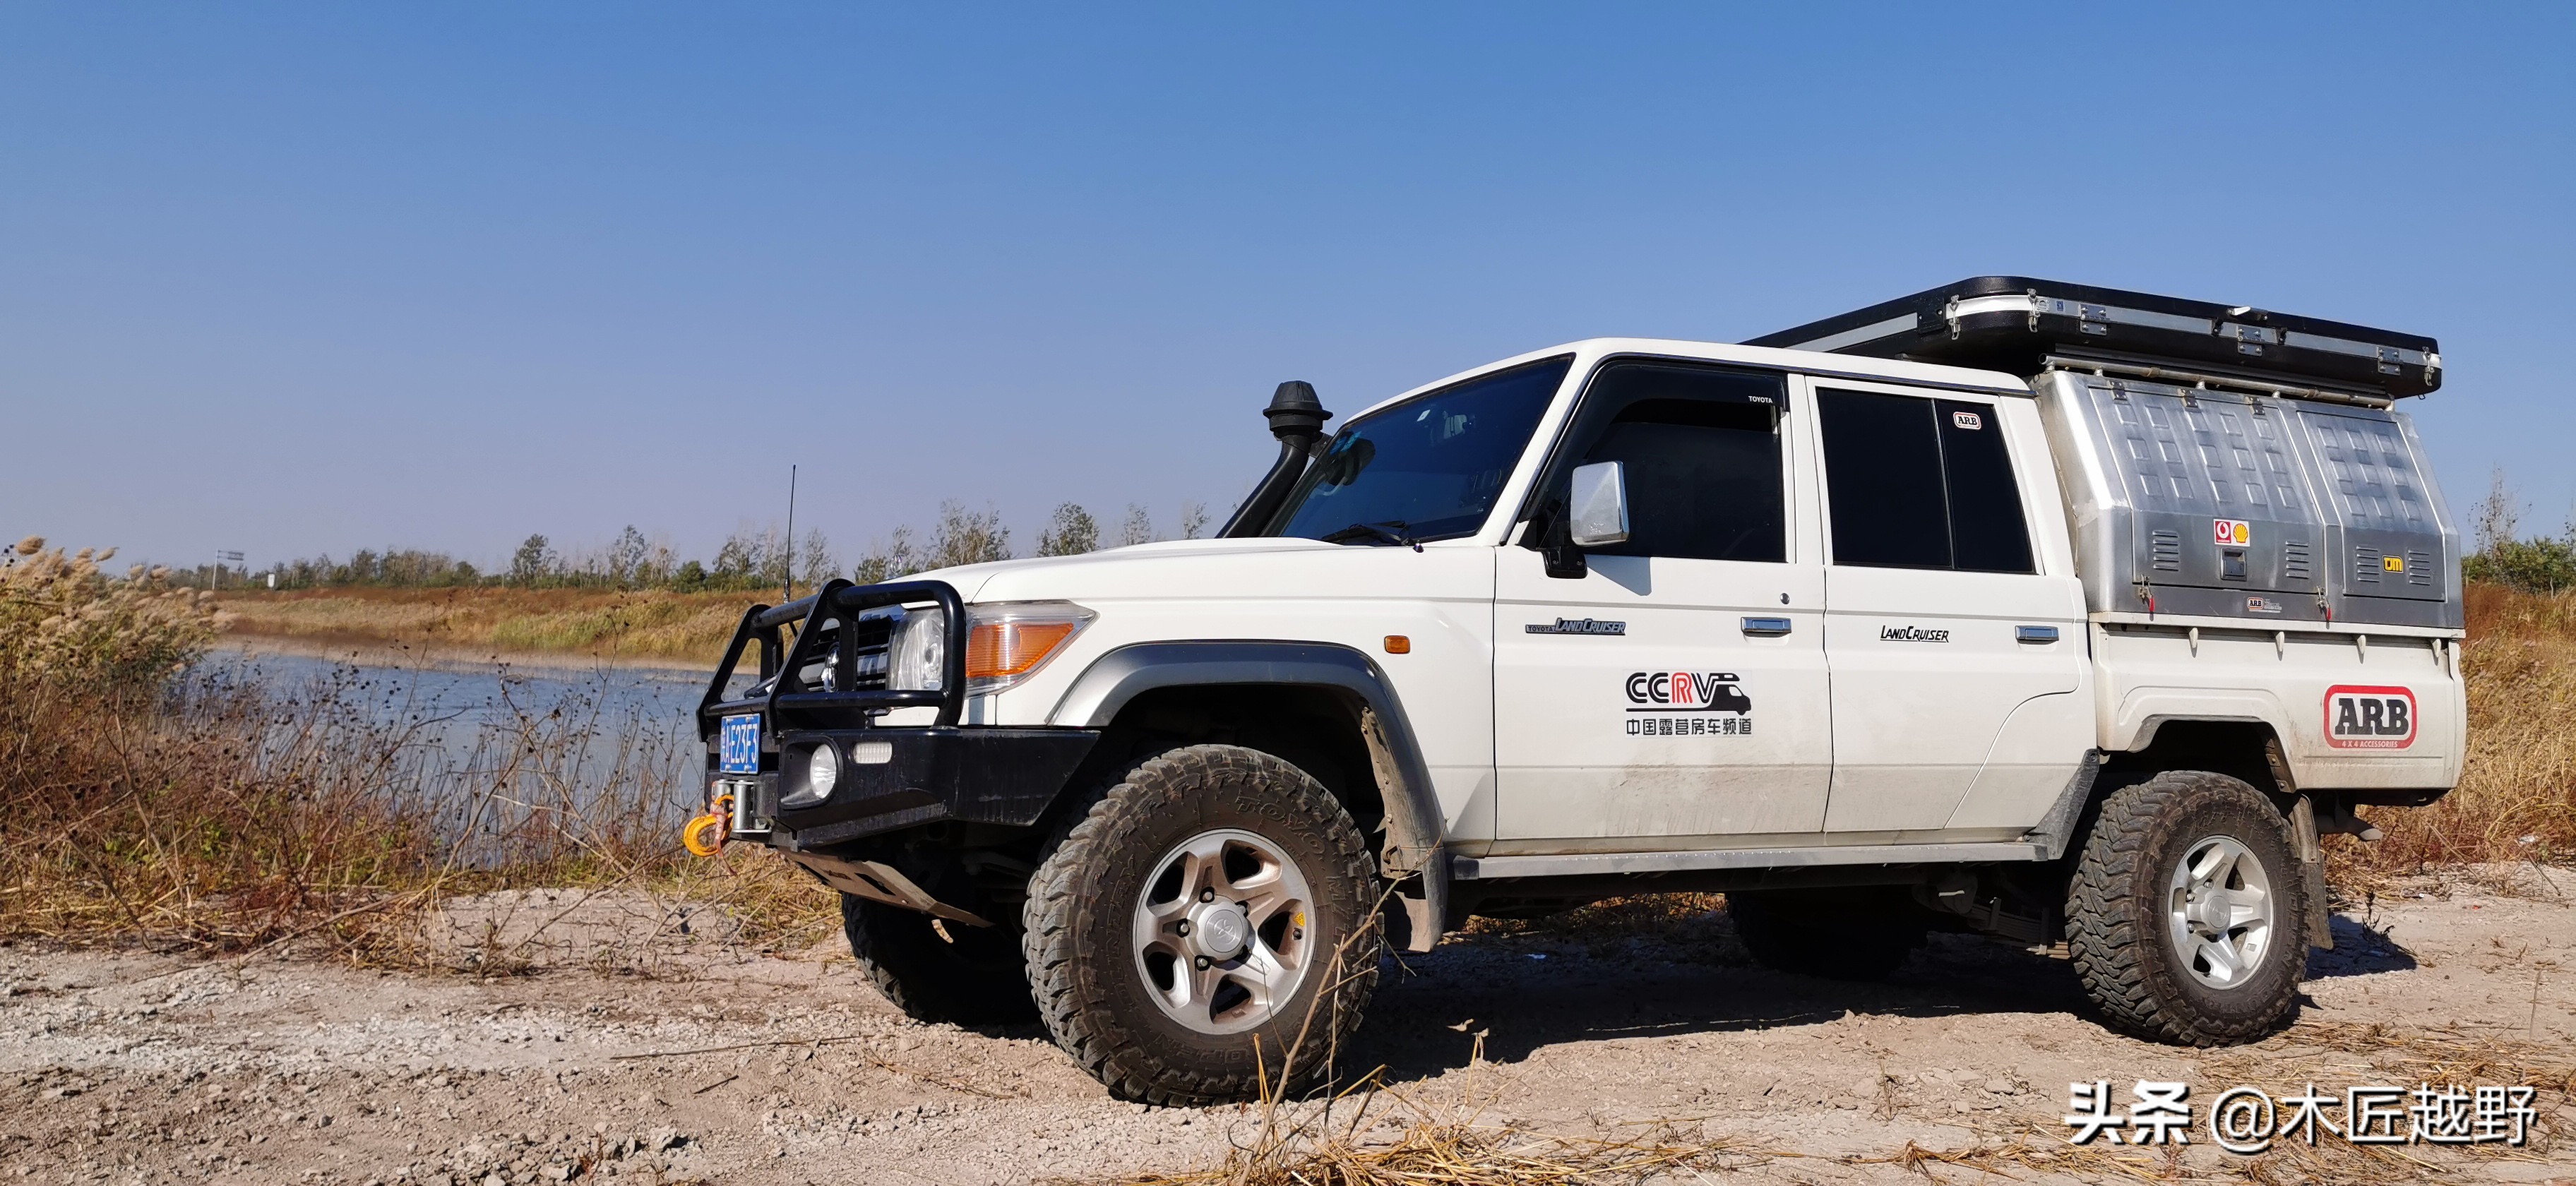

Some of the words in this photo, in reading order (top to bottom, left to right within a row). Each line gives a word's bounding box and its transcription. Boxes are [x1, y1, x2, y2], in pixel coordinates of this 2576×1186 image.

[1957, 416, 1978, 425] ARB
[2334, 697, 2409, 736] ARB
[1626, 717, 1752, 736] 中国露营房车频道
